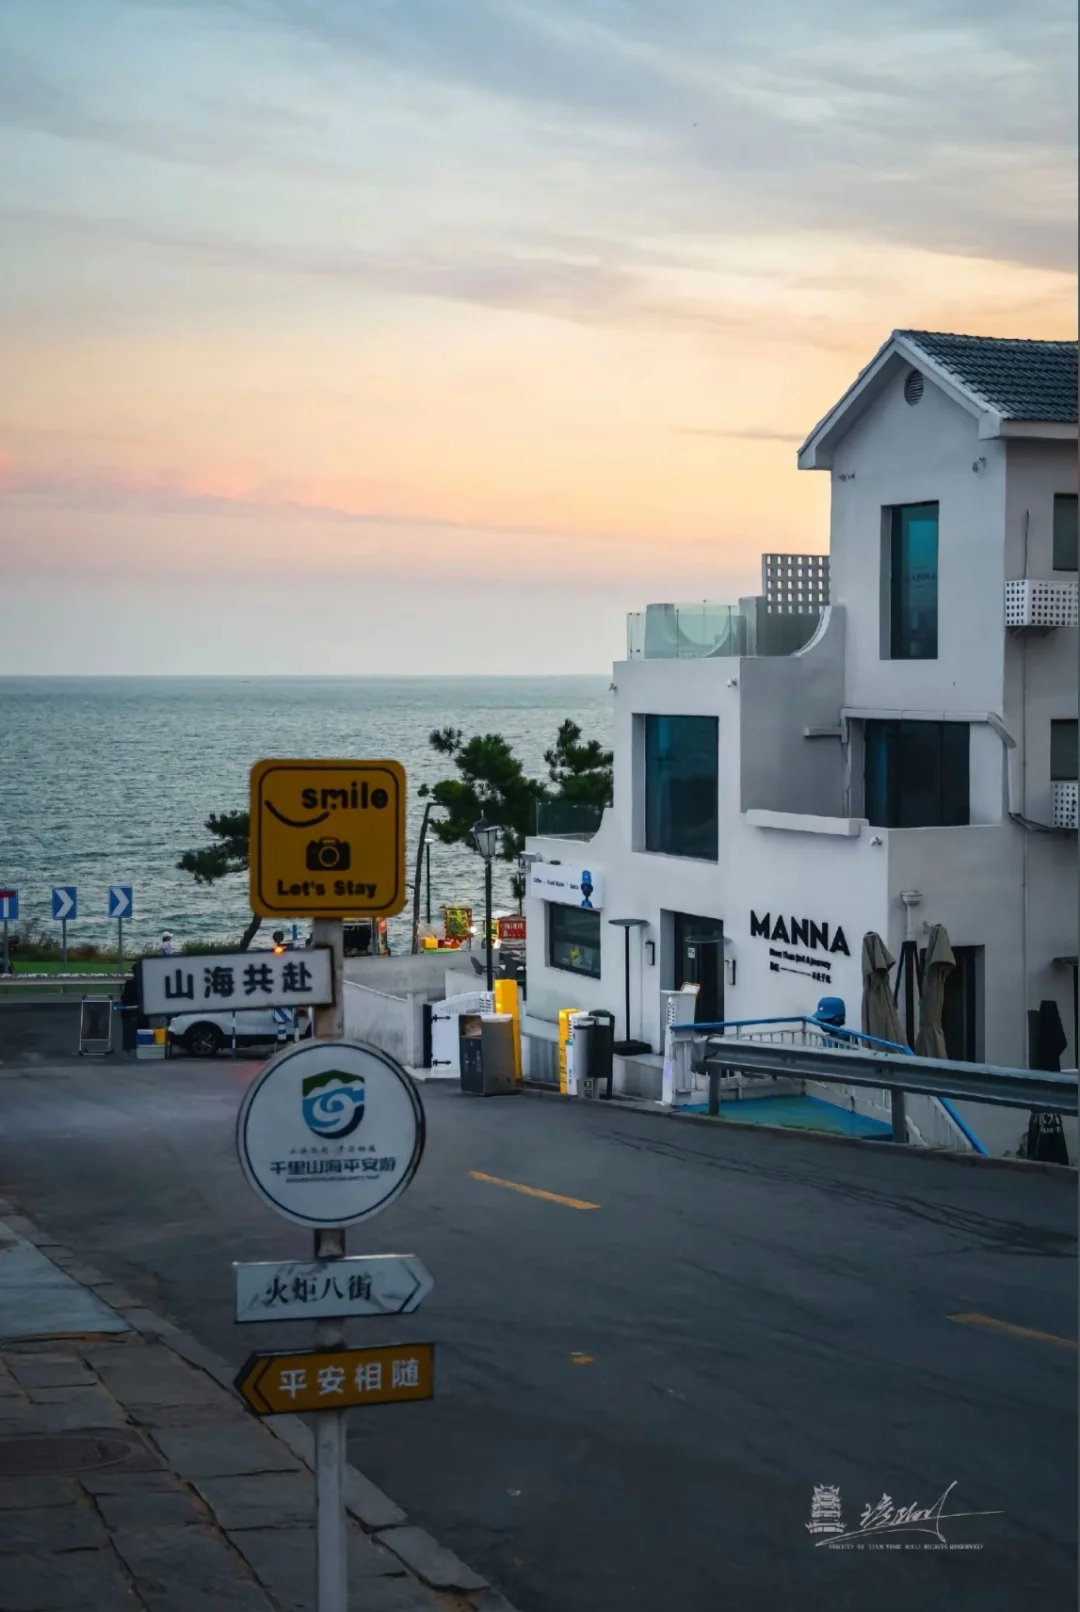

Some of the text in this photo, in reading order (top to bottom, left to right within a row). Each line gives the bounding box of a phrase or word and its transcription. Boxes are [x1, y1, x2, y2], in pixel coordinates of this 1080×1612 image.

[301, 780, 390, 811] smile
[276, 878, 378, 900] Let's Stay
[749, 908, 851, 957] MANNA
[164, 960, 314, 1000] 山海共赴
[265, 1272, 373, 1305] 火炬八街
[279, 1357, 420, 1400] 平安相随
